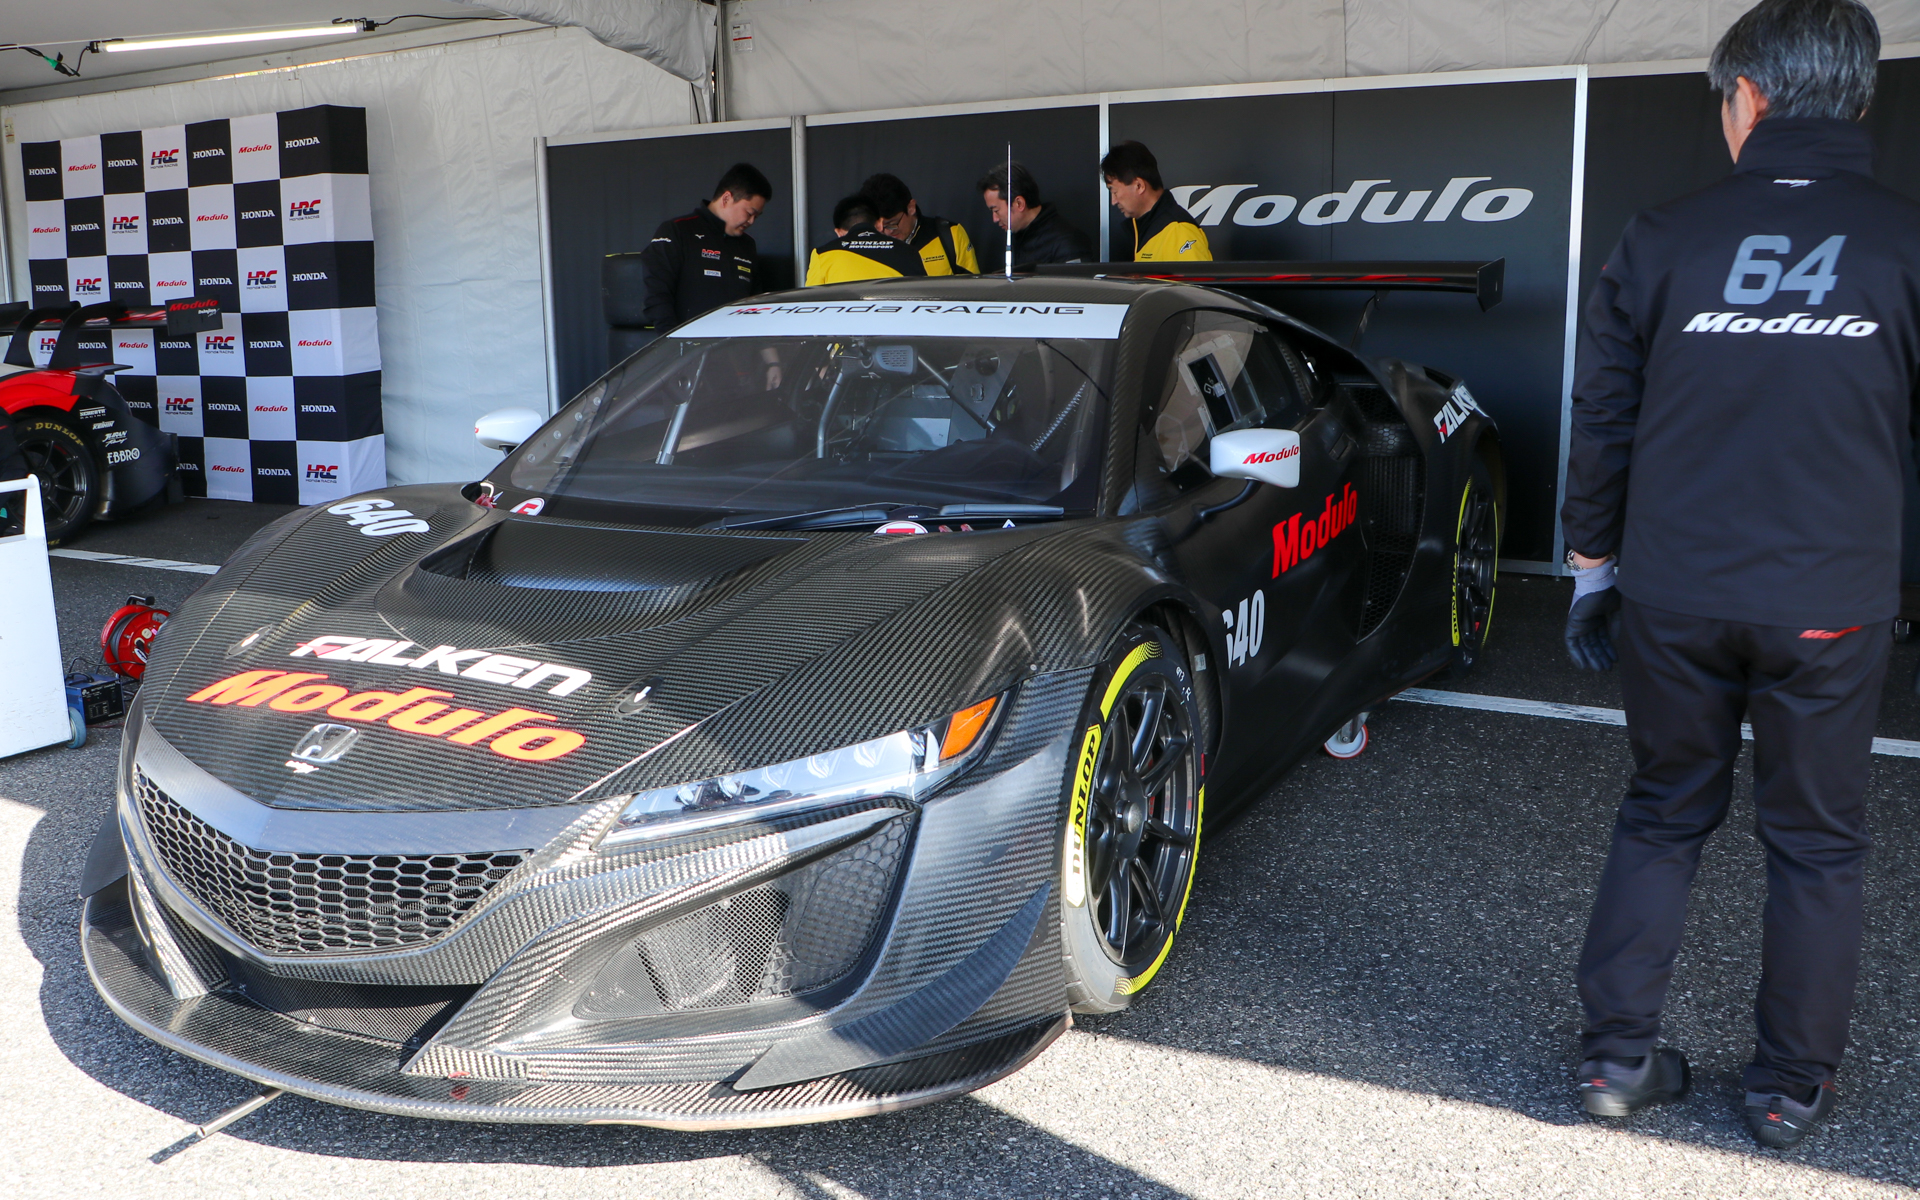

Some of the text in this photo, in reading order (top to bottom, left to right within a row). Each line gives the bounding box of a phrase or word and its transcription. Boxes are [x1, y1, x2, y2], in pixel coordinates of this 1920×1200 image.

[239, 144, 272, 153] Modulo
[285, 137, 320, 148] HONDA
[151, 149, 179, 165] HRC
[193, 149, 225, 159] HONDA
[108, 159, 138, 167] HONDA
[290, 199, 321, 217] HRC
[1169, 176, 1534, 226] Modulo
[153, 217, 183, 225] HONDA
[241, 210, 275, 219] HONDA
[71, 223, 99, 231] HONDA
[112, 216, 139, 230] HRC
[293, 272, 327, 281] HONDA
[1723, 234, 1847, 305] 64
[76, 278, 102, 292] HRC
[247, 270, 277, 286] HRC
[169, 299, 218, 312] Modulo
[771, 304, 902, 315] Honda
[911, 305, 1085, 315] RACING
[1682, 312, 1880, 337] Modulo
[40, 338, 57, 351] HR
[205, 336, 235, 350] HRC
[126, 401, 152, 409] ONDA
[165, 398, 195, 411] HRC
[208, 403, 241, 411] HONDA
[35, 422, 84, 446] DUNLOP
[106, 447, 140, 465] EBBRO
[1242, 444, 1300, 465] Modulo
[258, 468, 291, 476] HONDA
[306, 464, 338, 479] HRC
[327, 498, 430, 537] 640
[1272, 481, 1358, 580] Modulo
[289, 635, 593, 697] FALKEN
[186, 669, 587, 761] Modulo
[1072, 733, 1096, 875] DUNLOP
